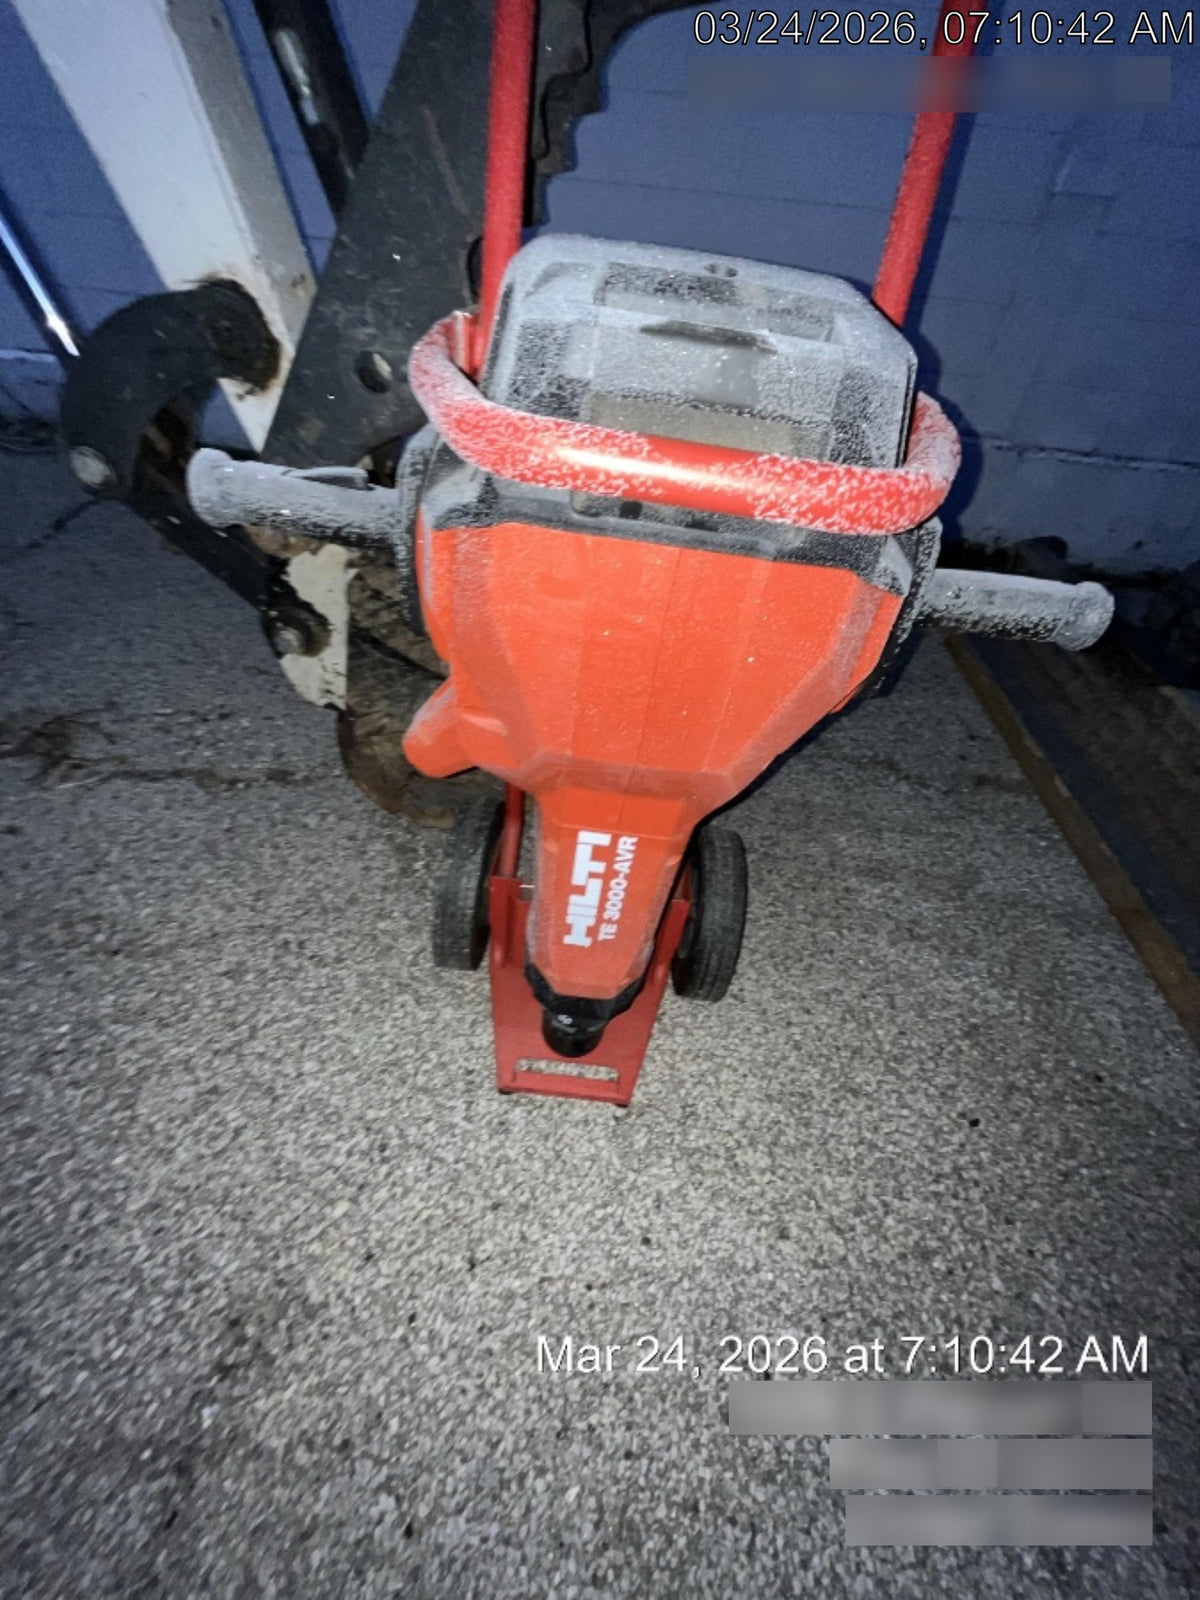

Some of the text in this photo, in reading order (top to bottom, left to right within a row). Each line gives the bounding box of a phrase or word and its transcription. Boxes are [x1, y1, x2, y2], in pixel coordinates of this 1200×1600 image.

[564, 831, 612, 947] HILTI
[598, 836, 639, 941] TE 3000-AVR
